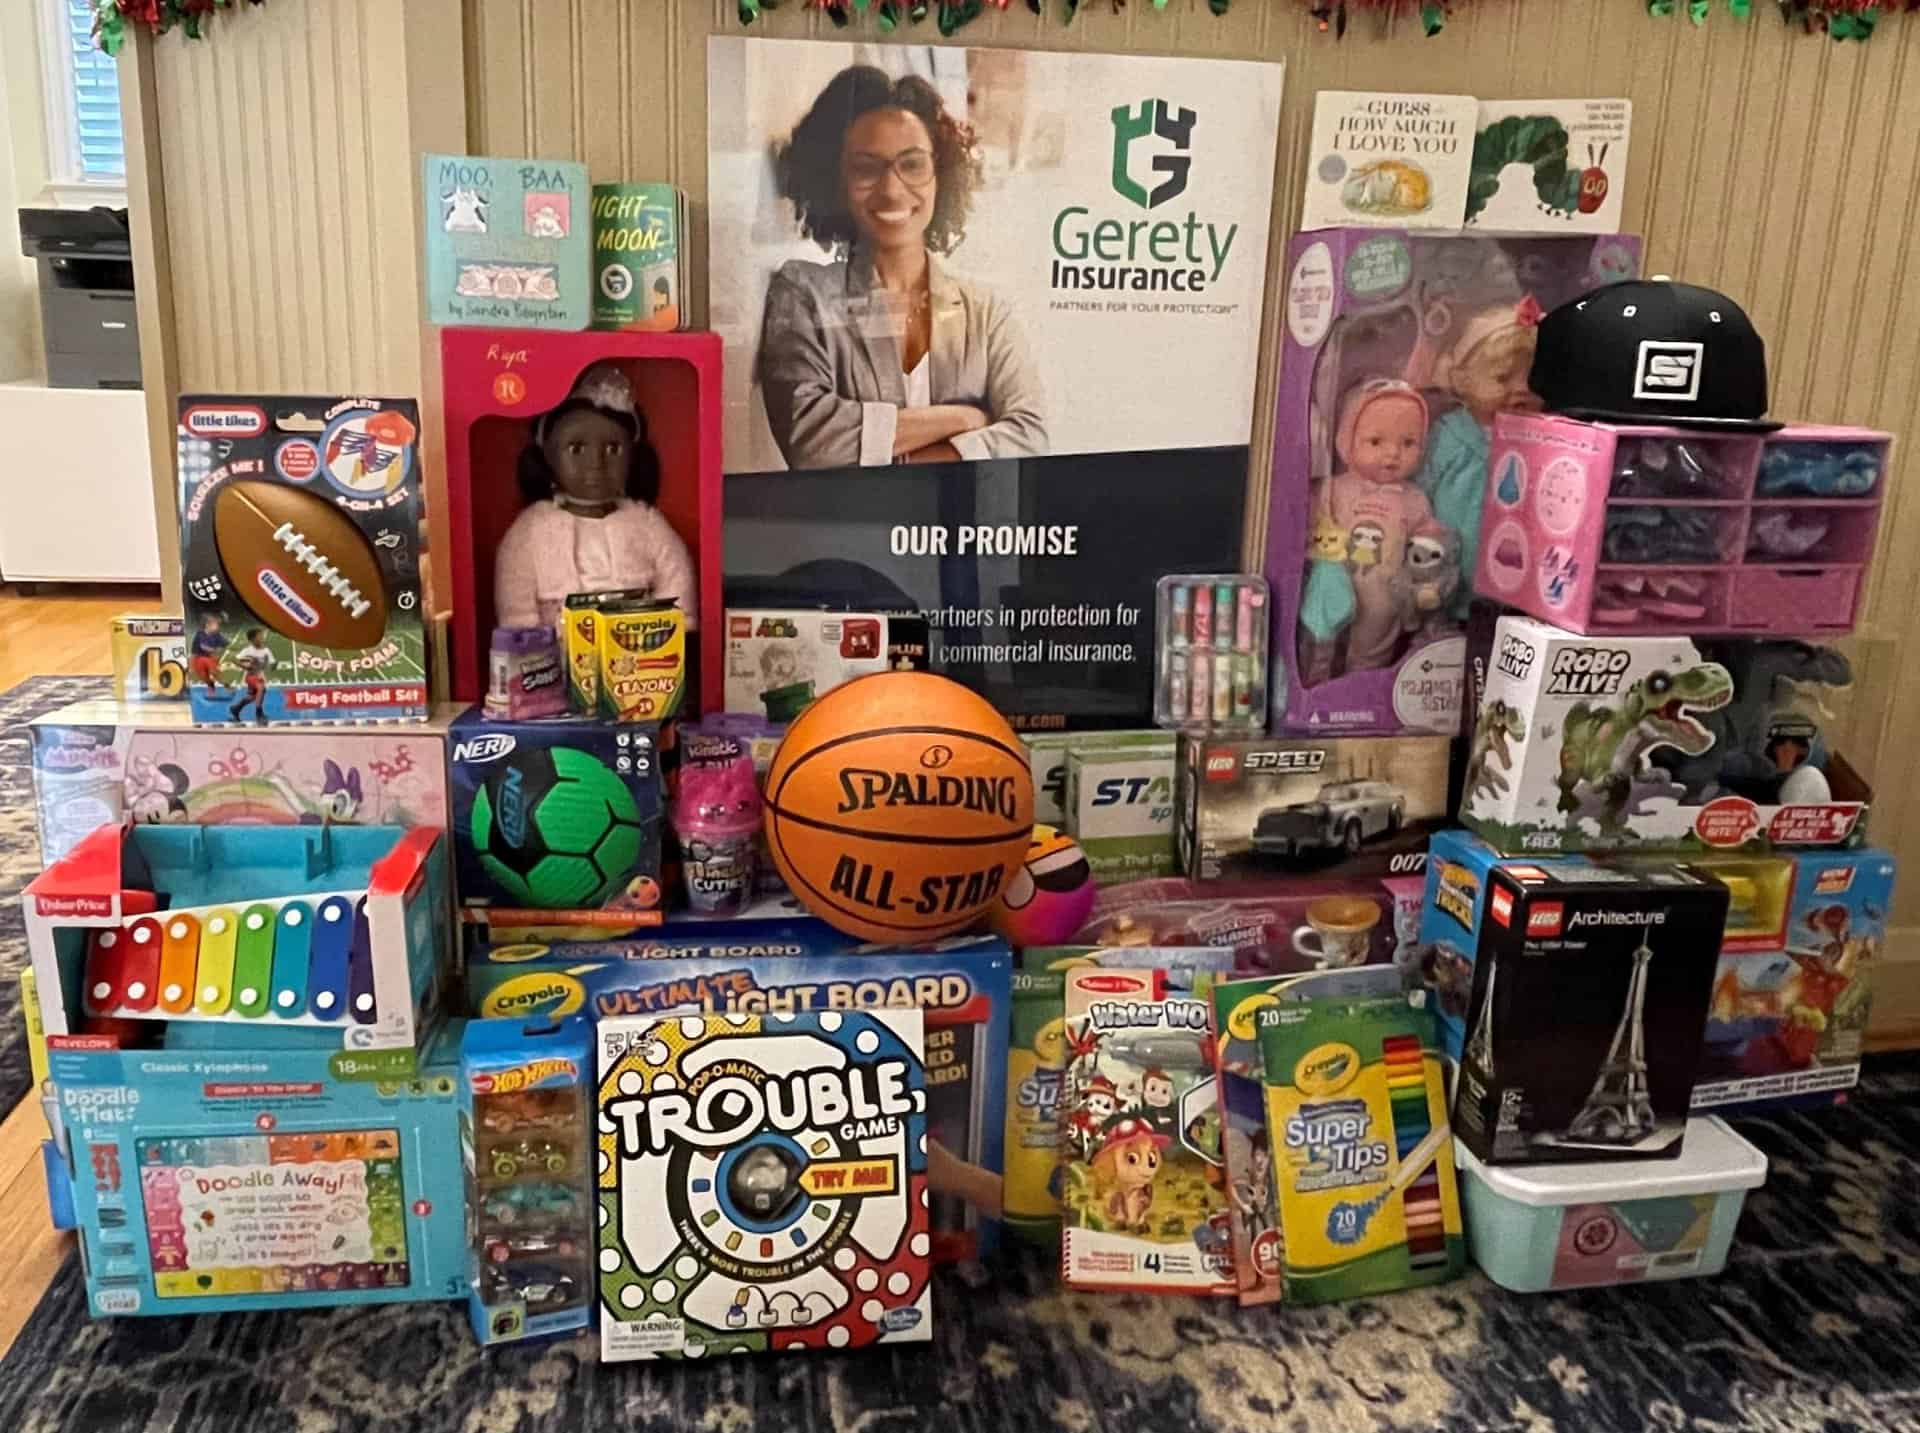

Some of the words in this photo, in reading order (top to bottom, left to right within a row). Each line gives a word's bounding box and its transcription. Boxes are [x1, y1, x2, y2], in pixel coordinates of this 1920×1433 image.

[1367, 100, 1431, 116] GUESS
[1339, 117, 1388, 134] HOW
[1394, 119, 1456, 136] MUCH
[1333, 133, 1342, 150] I
[1348, 134, 1407, 152] LOVE
[1412, 136, 1458, 154] YOU
[439, 162, 494, 188] MOO,
[597, 229, 658, 251] MOON
[1053, 206, 1238, 282] Gerety
[1051, 260, 1206, 292] Insurance
[1050, 301, 1103, 312] PARTNERS
[1106, 302, 1127, 313] FOR
[1131, 303, 1160, 314] YOUR
[192, 415, 223, 427] little
[891, 525, 948, 556] OUR
[958, 526, 1079, 556] PROMISE
[615, 618, 672, 633] Crayola
[999, 604, 1015, 626] in
[1020, 603, 1112, 630] protection
[1116, 603, 1141, 626] for
[297, 649, 344, 674] SOFT
[350, 643, 401, 672] FOAM
[939, 641, 1043, 663] commercial
[1048, 641, 1137, 663] insurance.
[1501, 633, 1535, 664] ROBO
[1552, 648, 1631, 675] ROBO
[614, 678, 676, 697] CRAYONS
[1546, 672, 1623, 695] ALIVE
[296, 691, 330, 708] Flag
[332, 690, 390, 705] Football
[395, 688, 418, 702] Set
[453, 735, 516, 762] NERF
[1244, 750, 1326, 769] SPEED
[838, 767, 1016, 821] SPALDING
[1390, 854, 1427, 872] 007
[830, 853, 1005, 915] ALL-STAR
[1568, 911, 1666, 932] Architecture
[709, 944, 802, 958] BOARD
[496, 982, 570, 1010] Crayola
[598, 972, 752, 1016] ULTIMATE
[832, 976, 973, 1010] BOARD
[1092, 1001, 1163, 1030] Water
[1164, 1001, 1210, 1029] WO
[1259, 1011, 1280, 1027] 20
[927, 1030, 955, 1049] ER
[141, 1061, 190, 1074] Classic
[691, 1062, 767, 1097] POP-O-MATIC
[63, 1085, 141, 1107] Doodle
[612, 1061, 913, 1154] TROUBLE
[840, 1118, 897, 1141] GAME
[1286, 1115, 1372, 1147] Super
[1331, 1140, 1388, 1173] Tips
[195, 1170, 274, 1195] Doodle
[282, 1169, 345, 1195] Away!
[811, 1166, 847, 1188] TRY
[852, 1163, 887, 1186] ME!
[1336, 1209, 1357, 1229] 20
[708, 1255, 739, 1274] MORE
[741, 1264, 790, 1278] TROUBLE
[1144, 1253, 1161, 1274] 4
